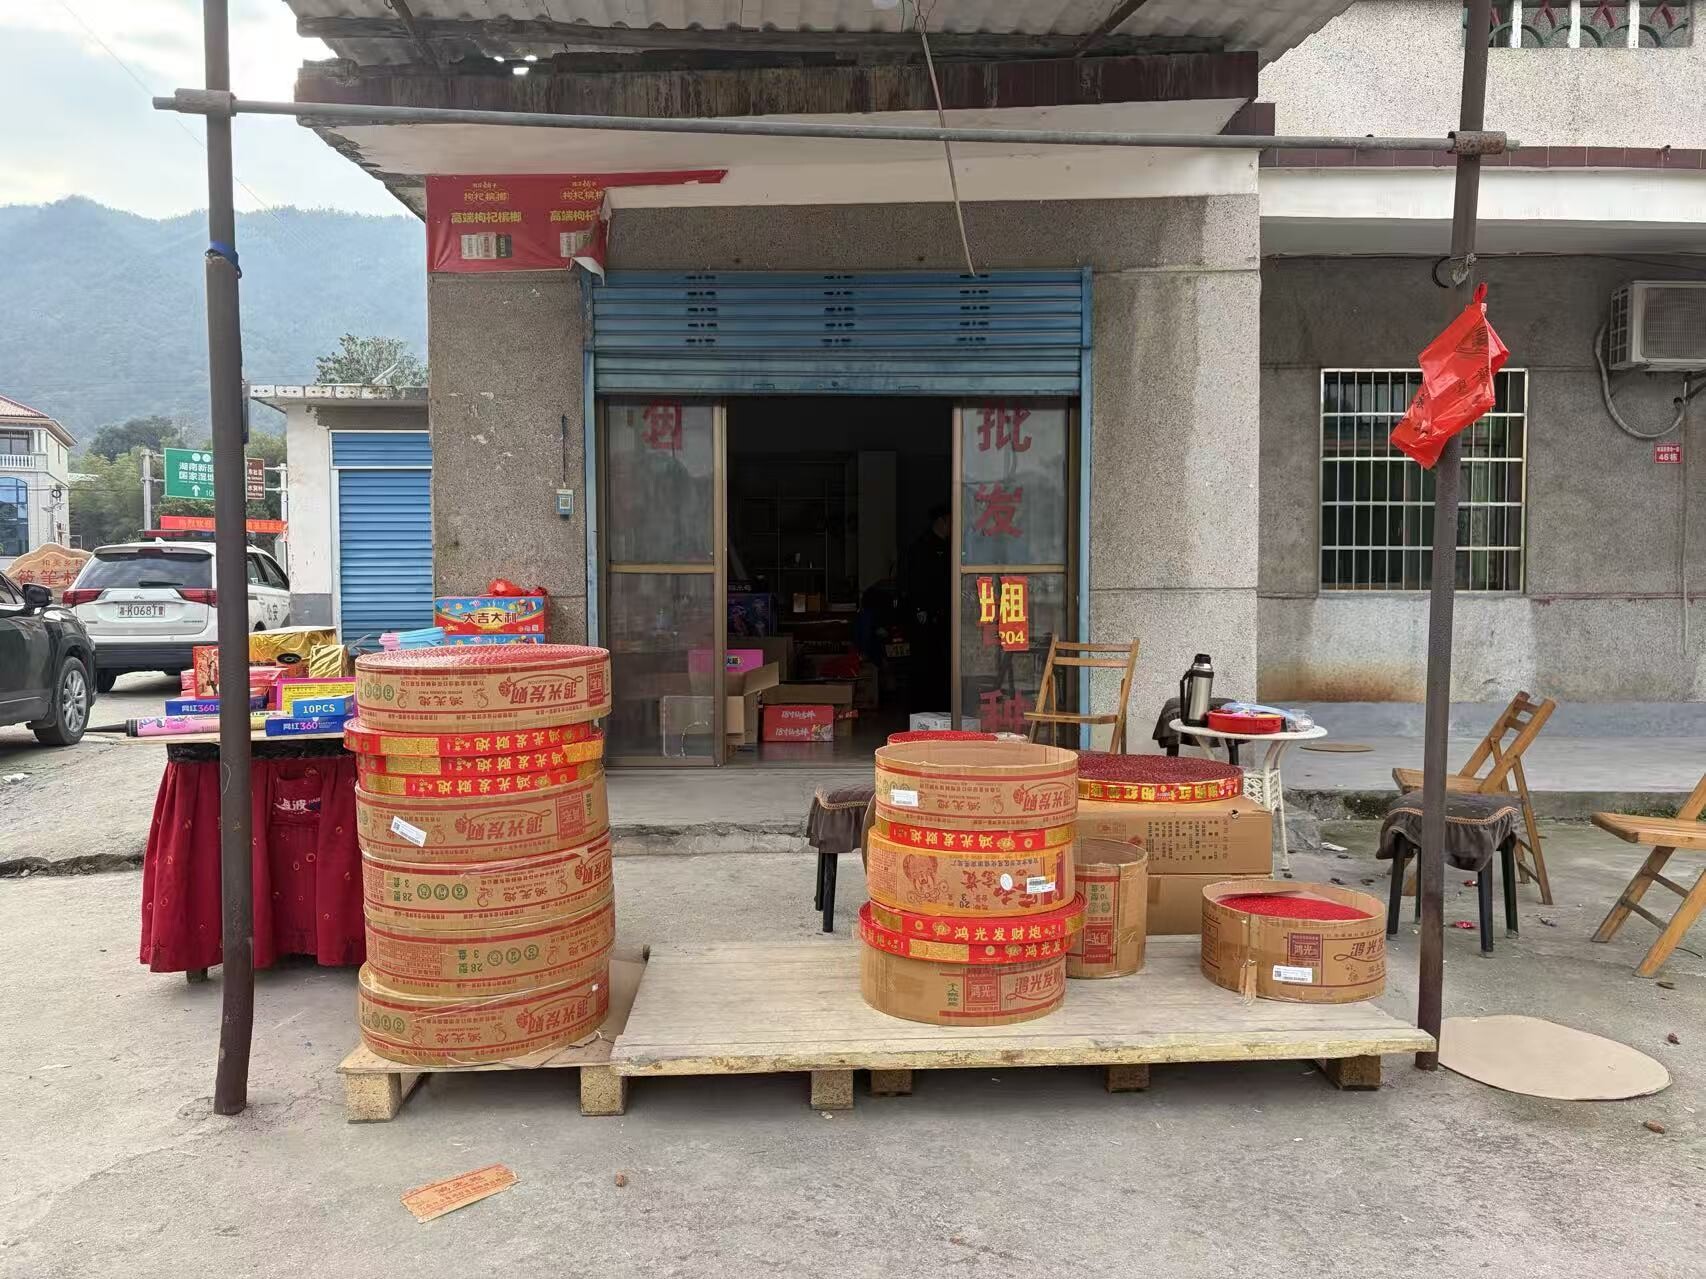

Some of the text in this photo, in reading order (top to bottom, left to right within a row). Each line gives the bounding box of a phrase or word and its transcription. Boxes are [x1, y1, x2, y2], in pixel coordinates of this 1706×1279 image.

[451, 211, 522, 224] 高端枸杞槟榔
[464, 613, 517, 624] 大吉大利
[303, 704, 335, 714] 10PCS
[474, 729, 561, 752] 鸿光发财炮
[475, 751, 564, 774] 鸿光发财炮
[436, 774, 531, 794] 鸿光发财炮
[909, 828, 993, 850] 鸿光发财炮
[954, 925, 1042, 941] 鸿光发财炮
